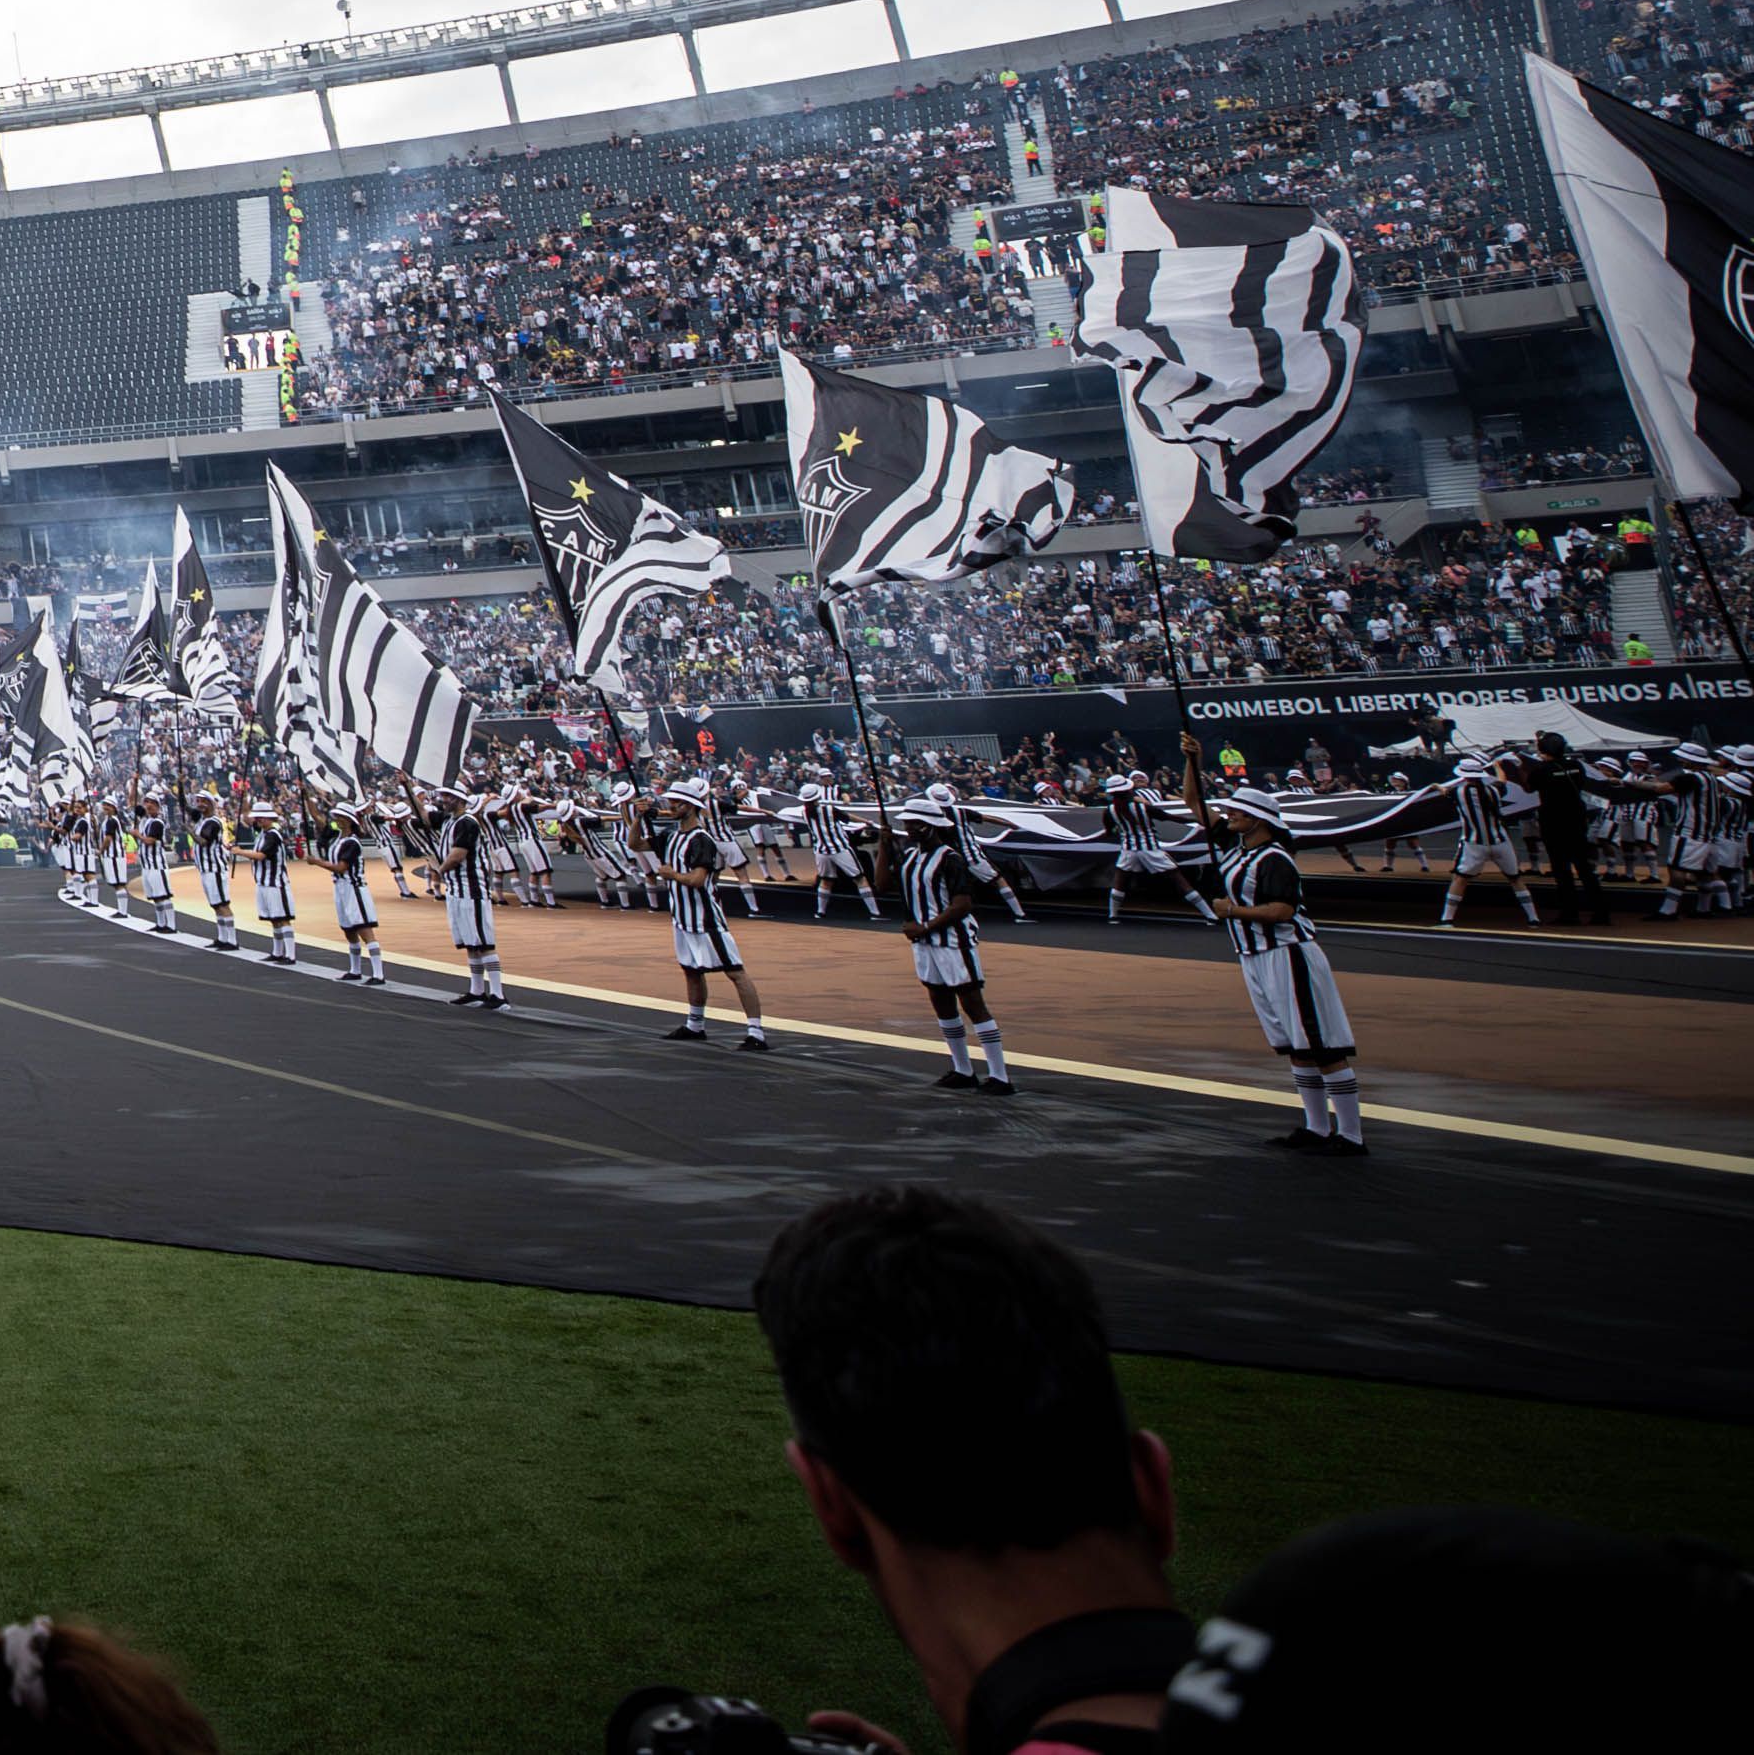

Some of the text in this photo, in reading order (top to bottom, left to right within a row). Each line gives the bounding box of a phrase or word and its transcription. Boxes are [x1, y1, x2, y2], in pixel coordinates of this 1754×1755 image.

[540, 520, 605, 561] CAM
[1188, 698, 1330, 720] CONMEBOL
[1542, 680, 1662, 705] BUENOS
[1668, 673, 1754, 701] AIRES
